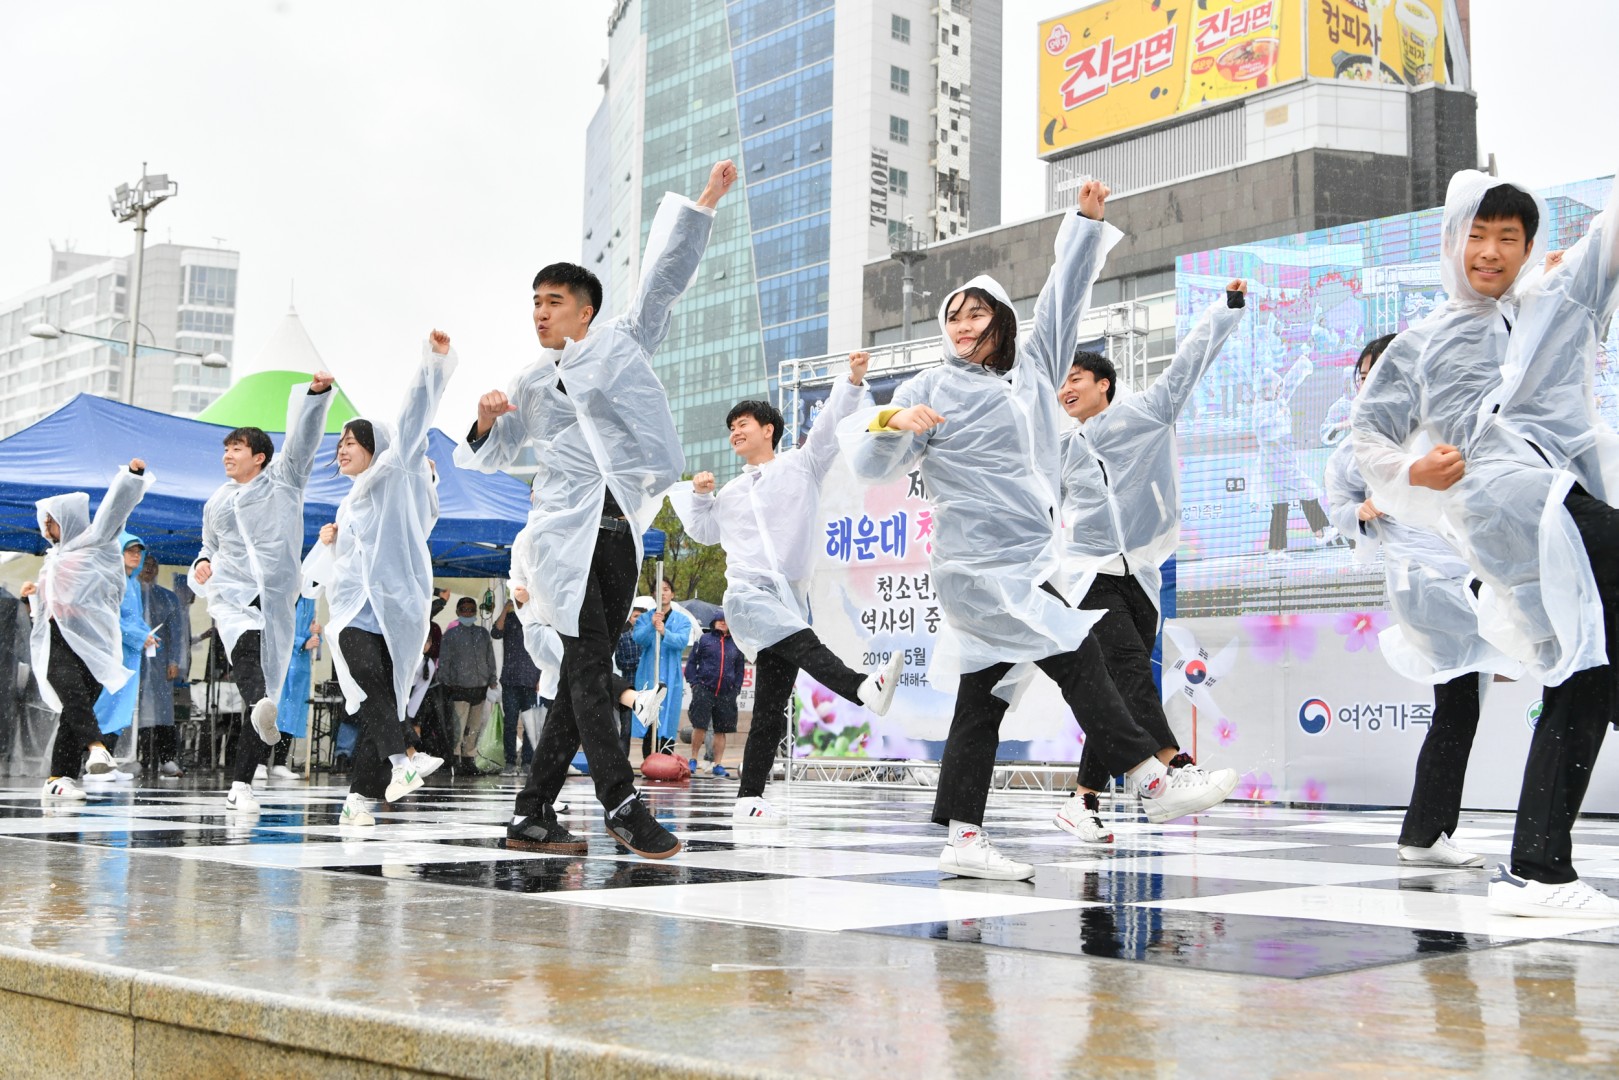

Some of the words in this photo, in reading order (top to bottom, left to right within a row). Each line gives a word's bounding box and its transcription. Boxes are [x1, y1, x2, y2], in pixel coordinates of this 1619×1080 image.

[1196, 1, 1273, 54] 진라면
[1322, 0, 1382, 56] 컵피자
[1061, 26, 1175, 109] 진라면
[870, 151, 889, 227] HOTEL
[826, 511, 907, 562] 해운대
[877, 573, 937, 602] 청소년,
[861, 606, 918, 636] 역사의
[924, 606, 942, 634] 중
[862, 651, 892, 666] 2019
[904, 647, 926, 667] 5월
[895, 672, 930, 688] 대해수
[1338, 704, 1432, 731] 여성가족
